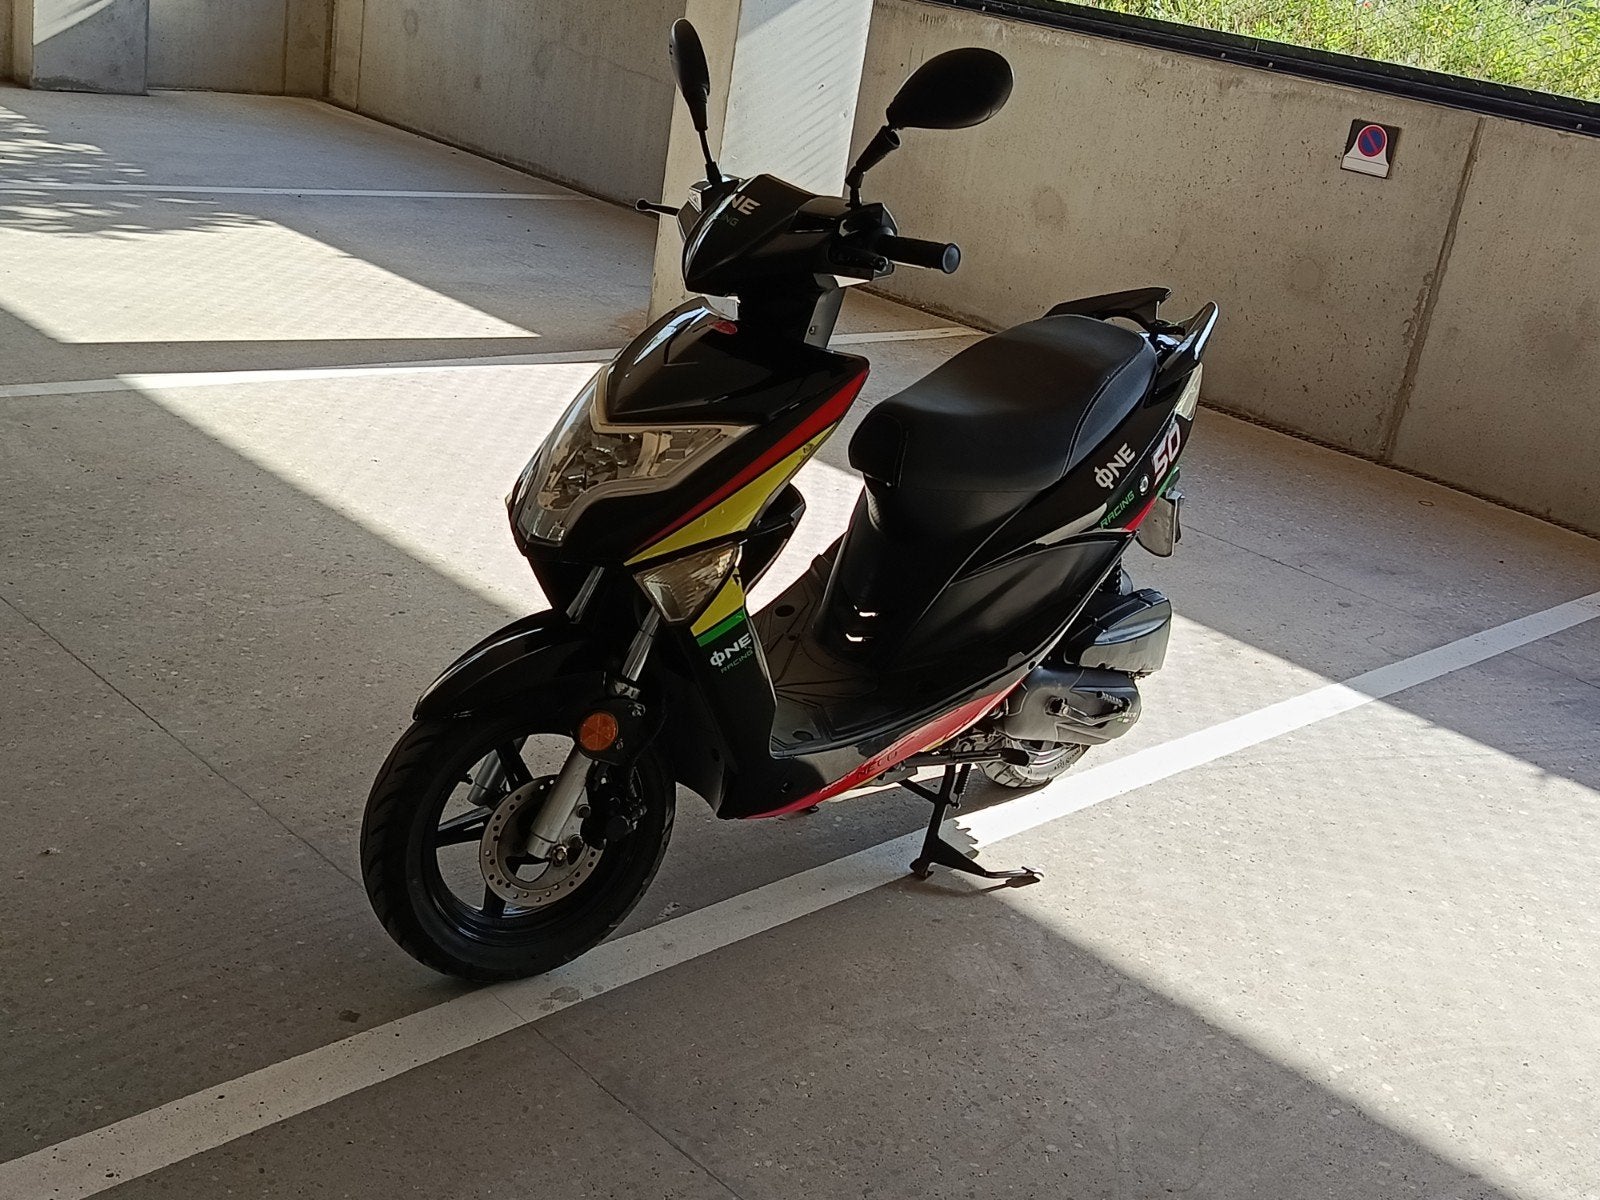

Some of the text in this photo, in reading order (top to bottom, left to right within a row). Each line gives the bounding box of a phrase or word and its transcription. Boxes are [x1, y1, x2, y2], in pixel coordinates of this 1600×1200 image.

[1152, 421, 1181, 486] 50
[1099, 490, 1135, 529] RACING
[720, 649, 754, 674] RACING
